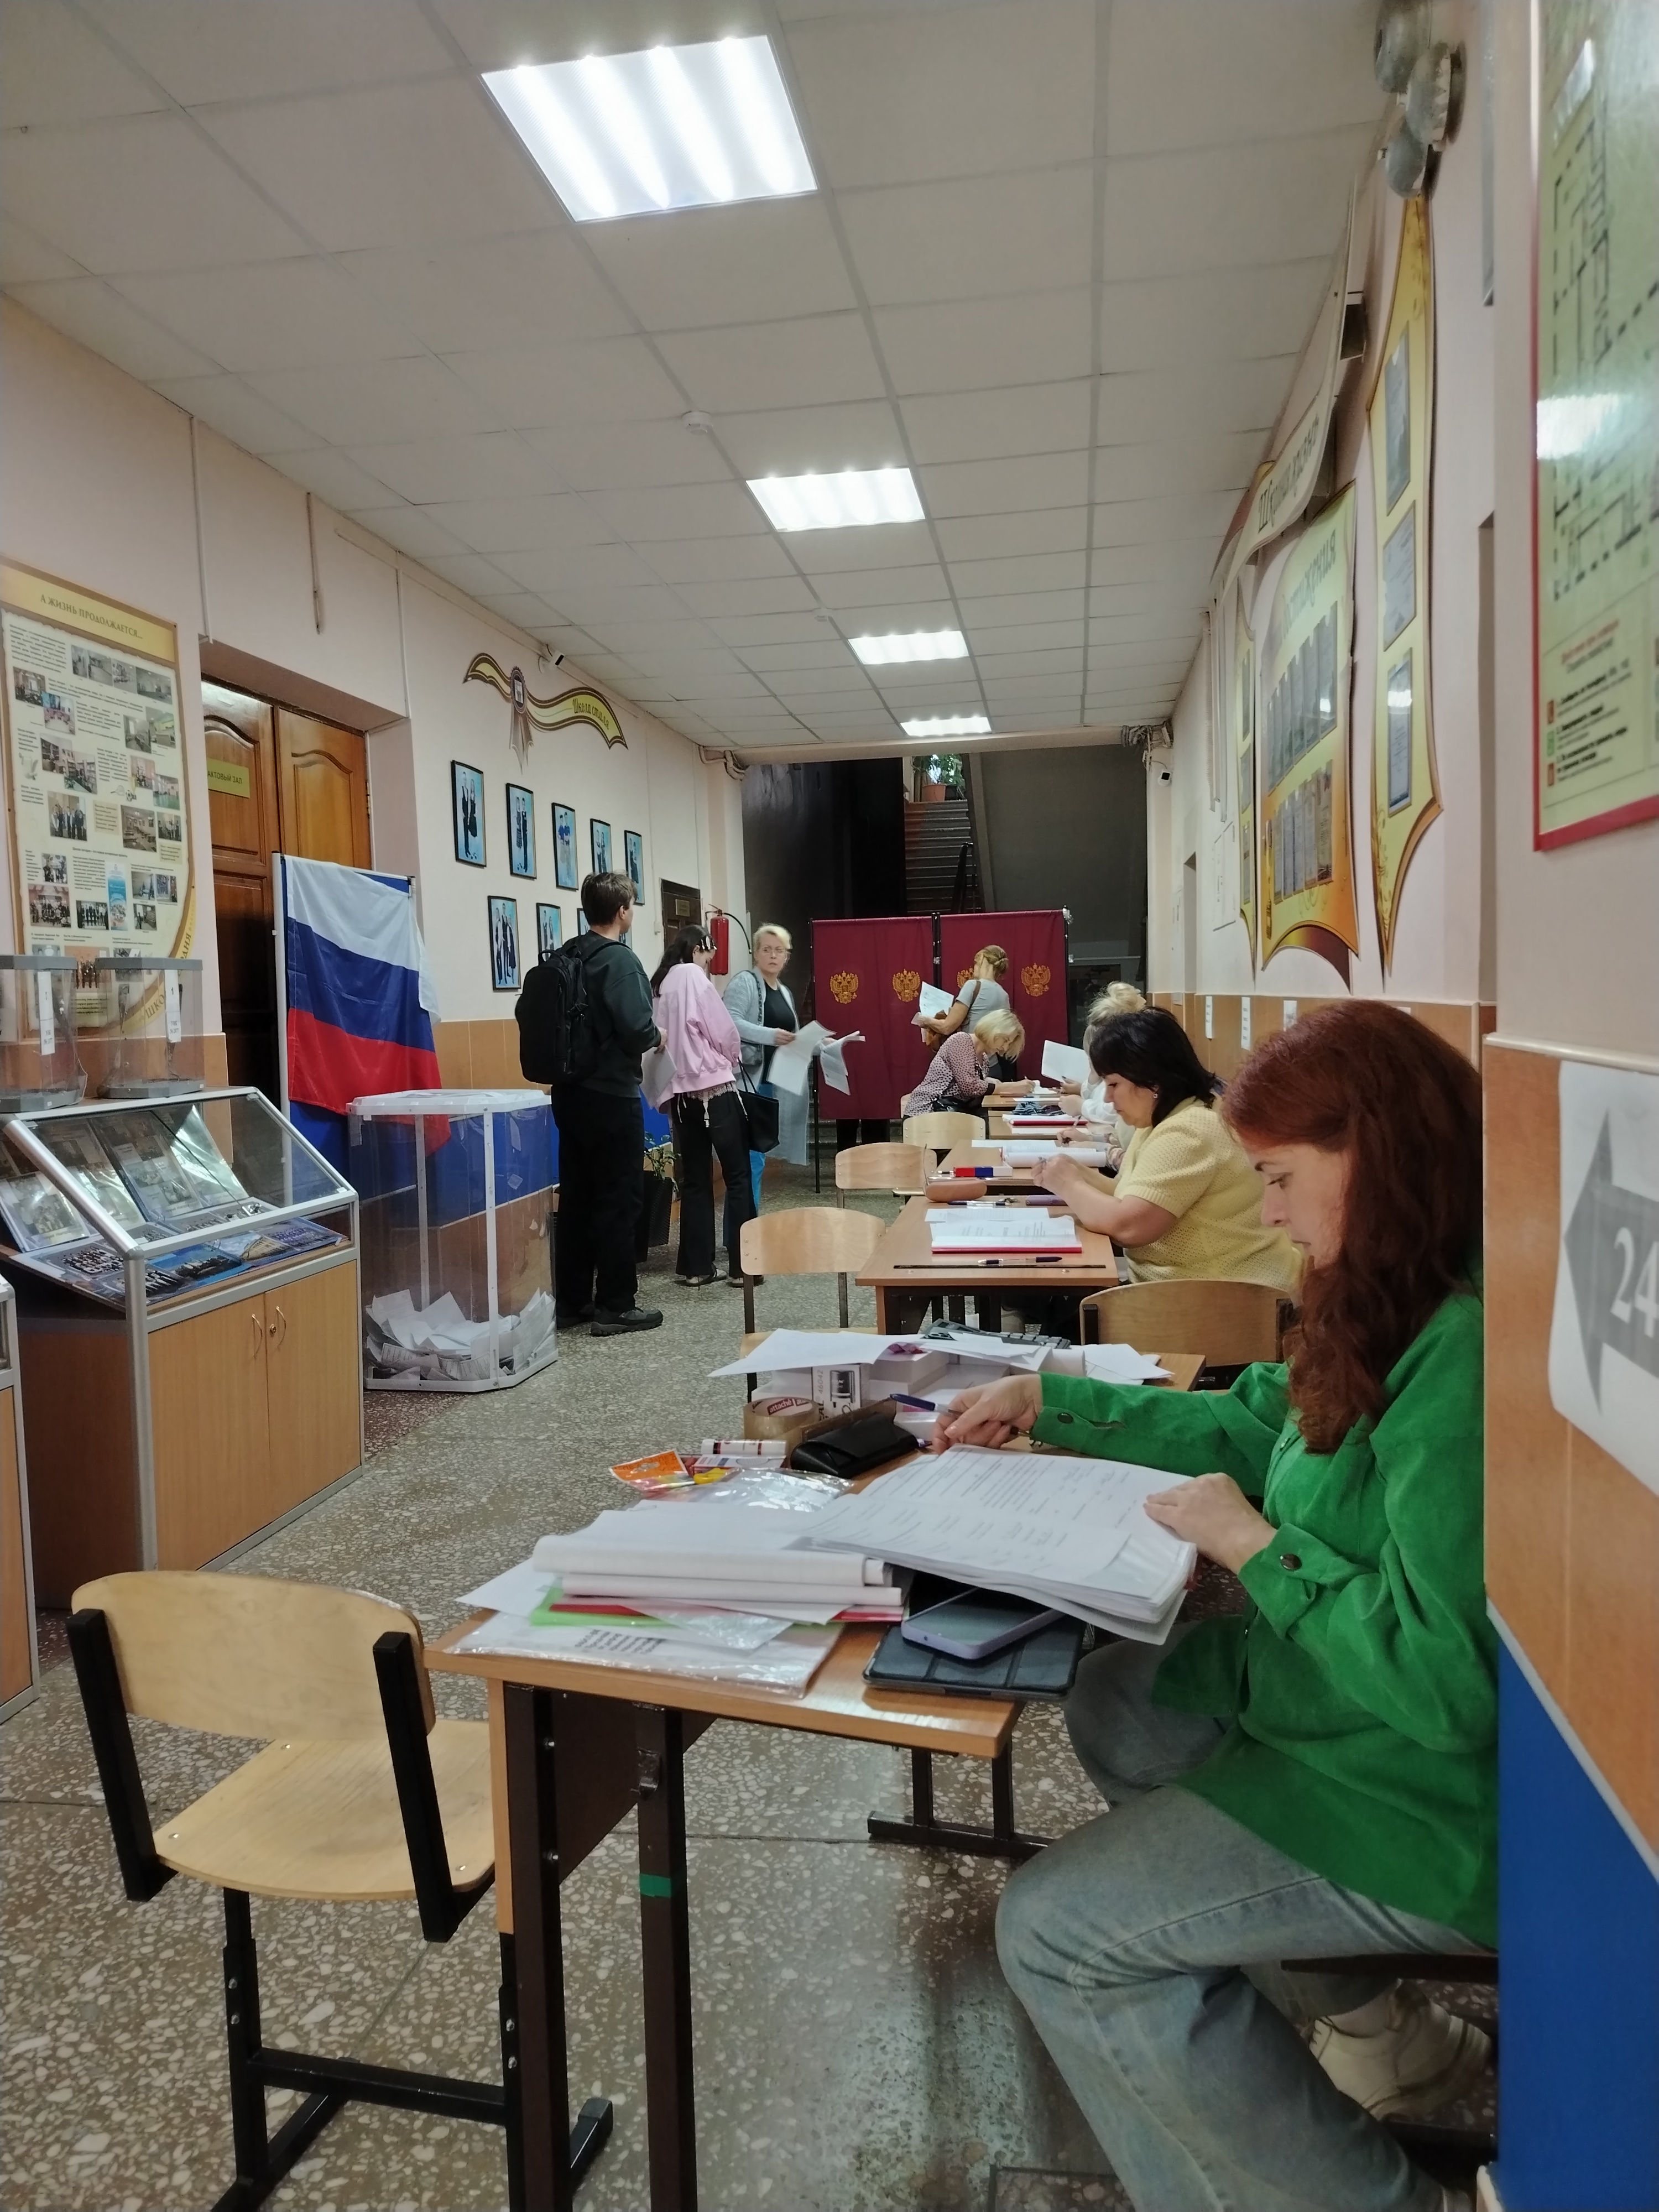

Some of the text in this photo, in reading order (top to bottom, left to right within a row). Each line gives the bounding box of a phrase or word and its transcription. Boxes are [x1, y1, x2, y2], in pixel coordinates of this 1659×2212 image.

[40, 593, 46, 604] А
[48, 597, 77, 614] ЖИЗНЬ
[207, 770, 242, 784] АКТОВЫЙ ЗАЛ
[145, 932, 191, 1019] ШКО ДНЯ
[769, 1398, 792, 1413] attaché
